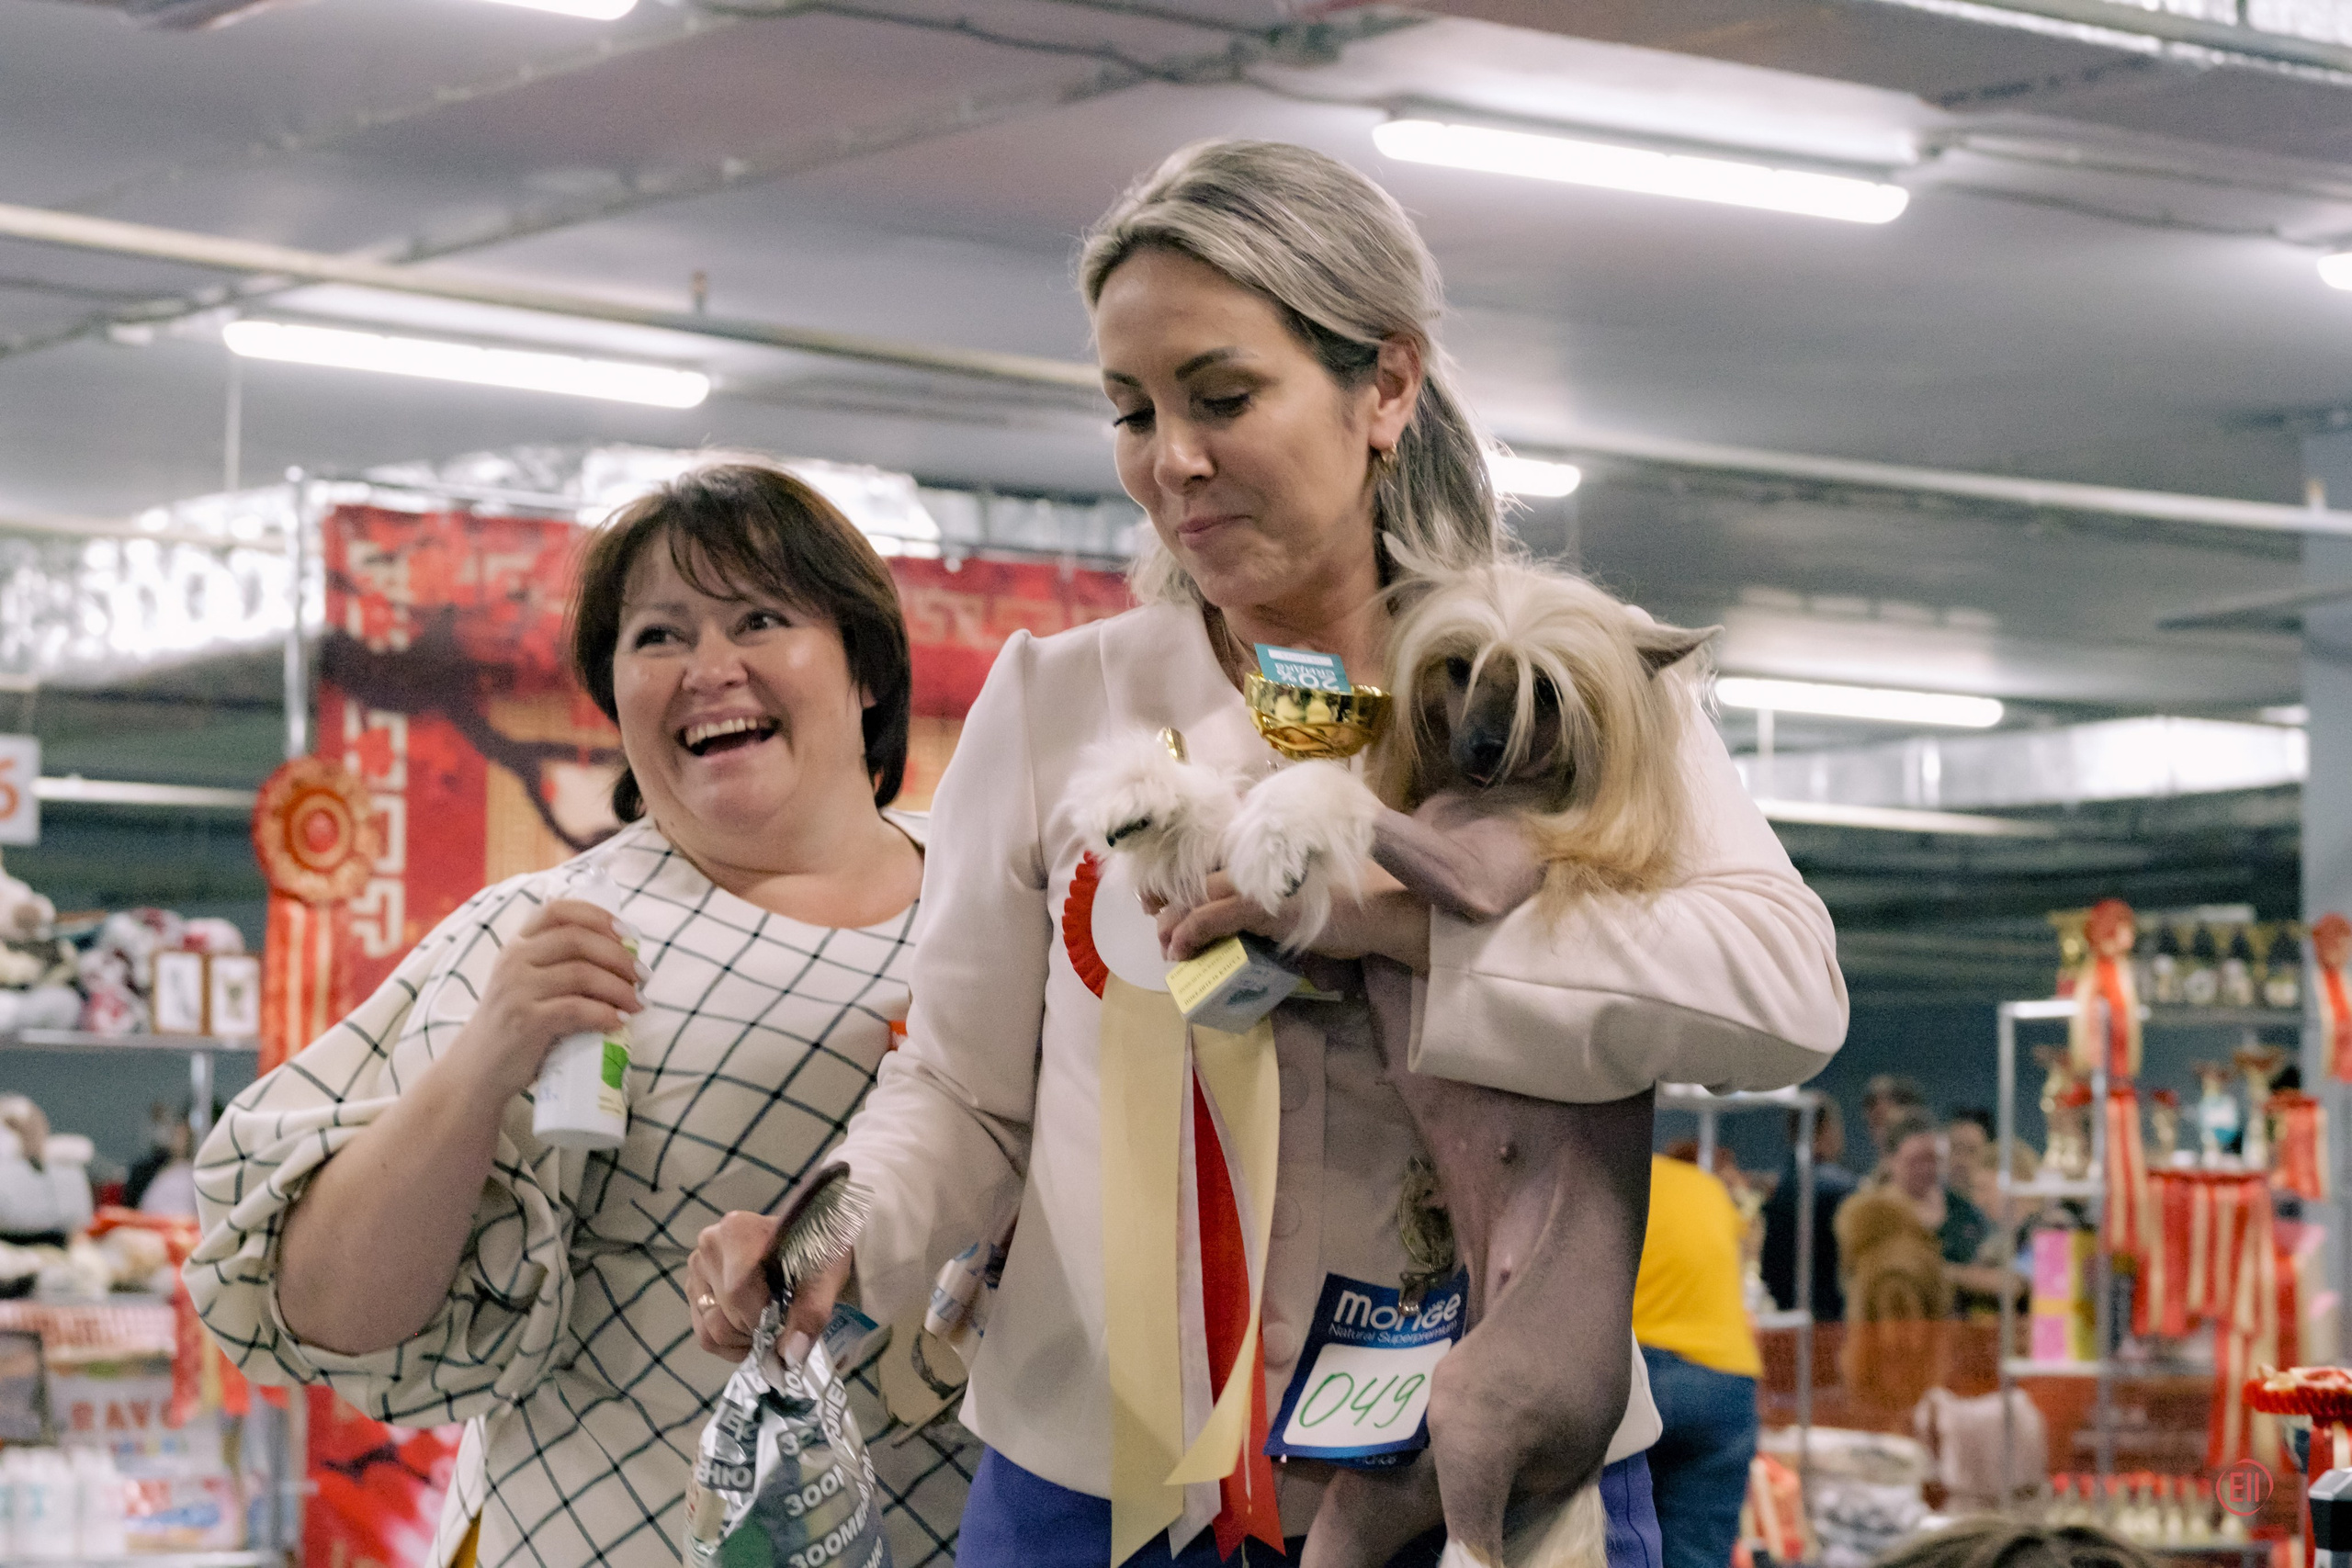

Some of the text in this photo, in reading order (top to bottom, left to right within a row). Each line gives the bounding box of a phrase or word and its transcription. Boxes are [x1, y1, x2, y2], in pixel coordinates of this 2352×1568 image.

[1276, 667, 1340, 691] 20%
[1329, 1319, 1458, 1345] Natural Superpremium
[1299, 1371, 1426, 1429] 049
